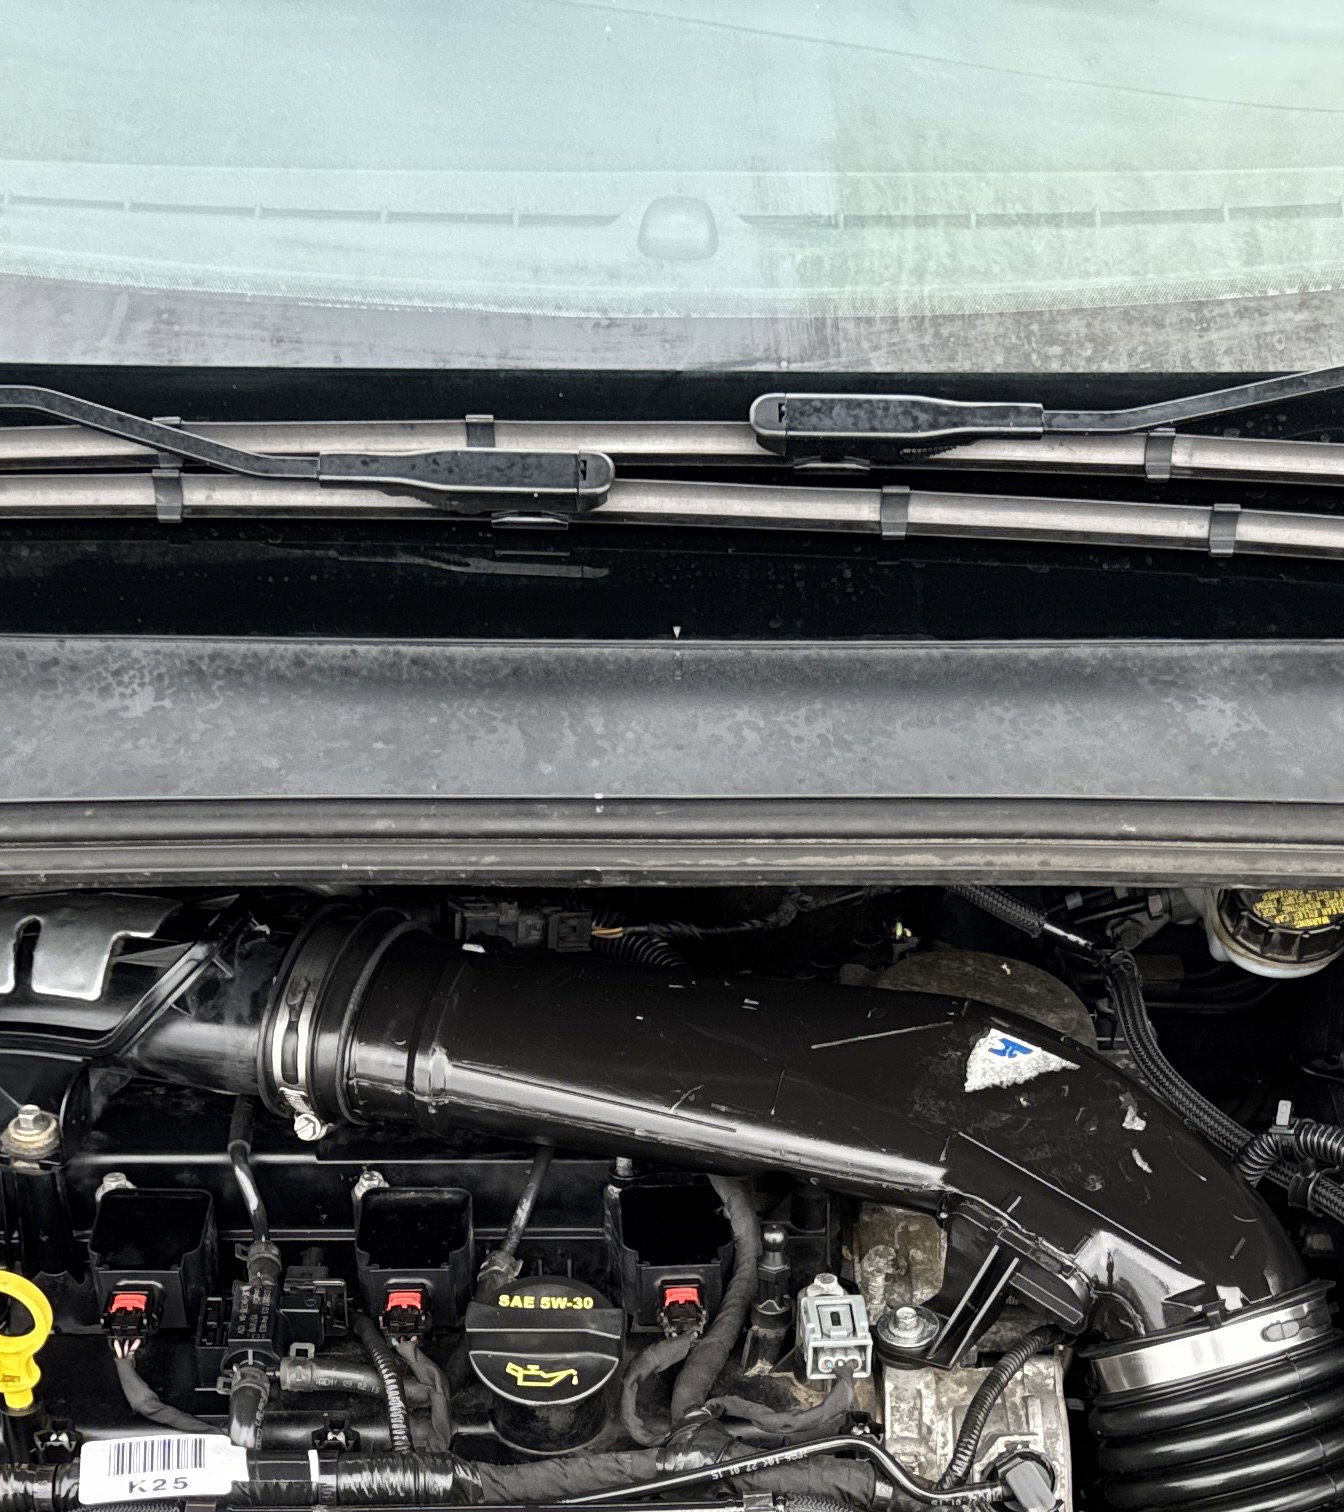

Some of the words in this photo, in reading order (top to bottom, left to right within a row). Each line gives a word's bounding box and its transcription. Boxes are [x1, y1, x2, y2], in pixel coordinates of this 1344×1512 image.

[498, 1294, 535, 1309] SAE
[540, 1296, 594, 1310] 5W-30
[128, 1476, 188, 1493] K25
